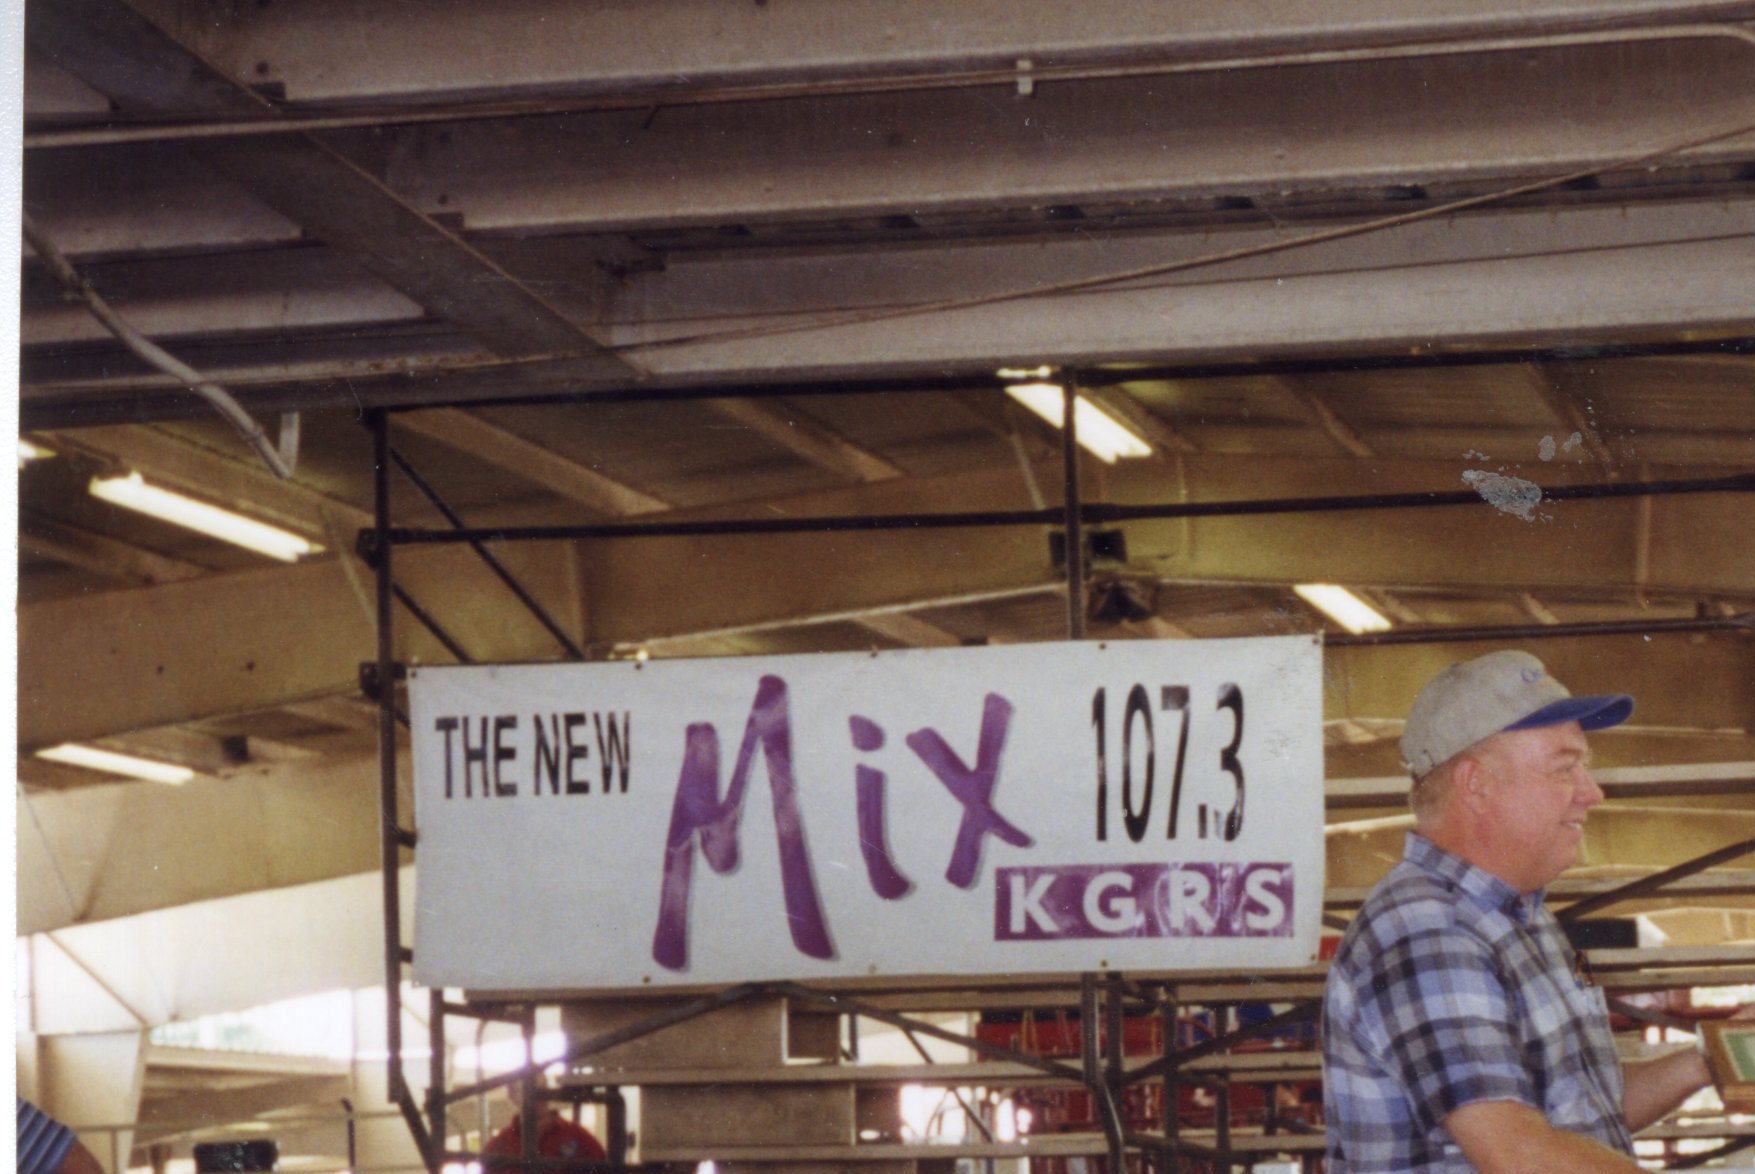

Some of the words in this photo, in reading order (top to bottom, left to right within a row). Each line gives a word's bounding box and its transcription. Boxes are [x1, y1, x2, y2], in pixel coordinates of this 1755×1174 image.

[435, 716, 518, 798] THE
[533, 711, 630, 796] NEW
[1092, 683, 1246, 842] 107.3
[653, 674, 1036, 971] Mix
[1009, 869, 1285, 933] KGRS
